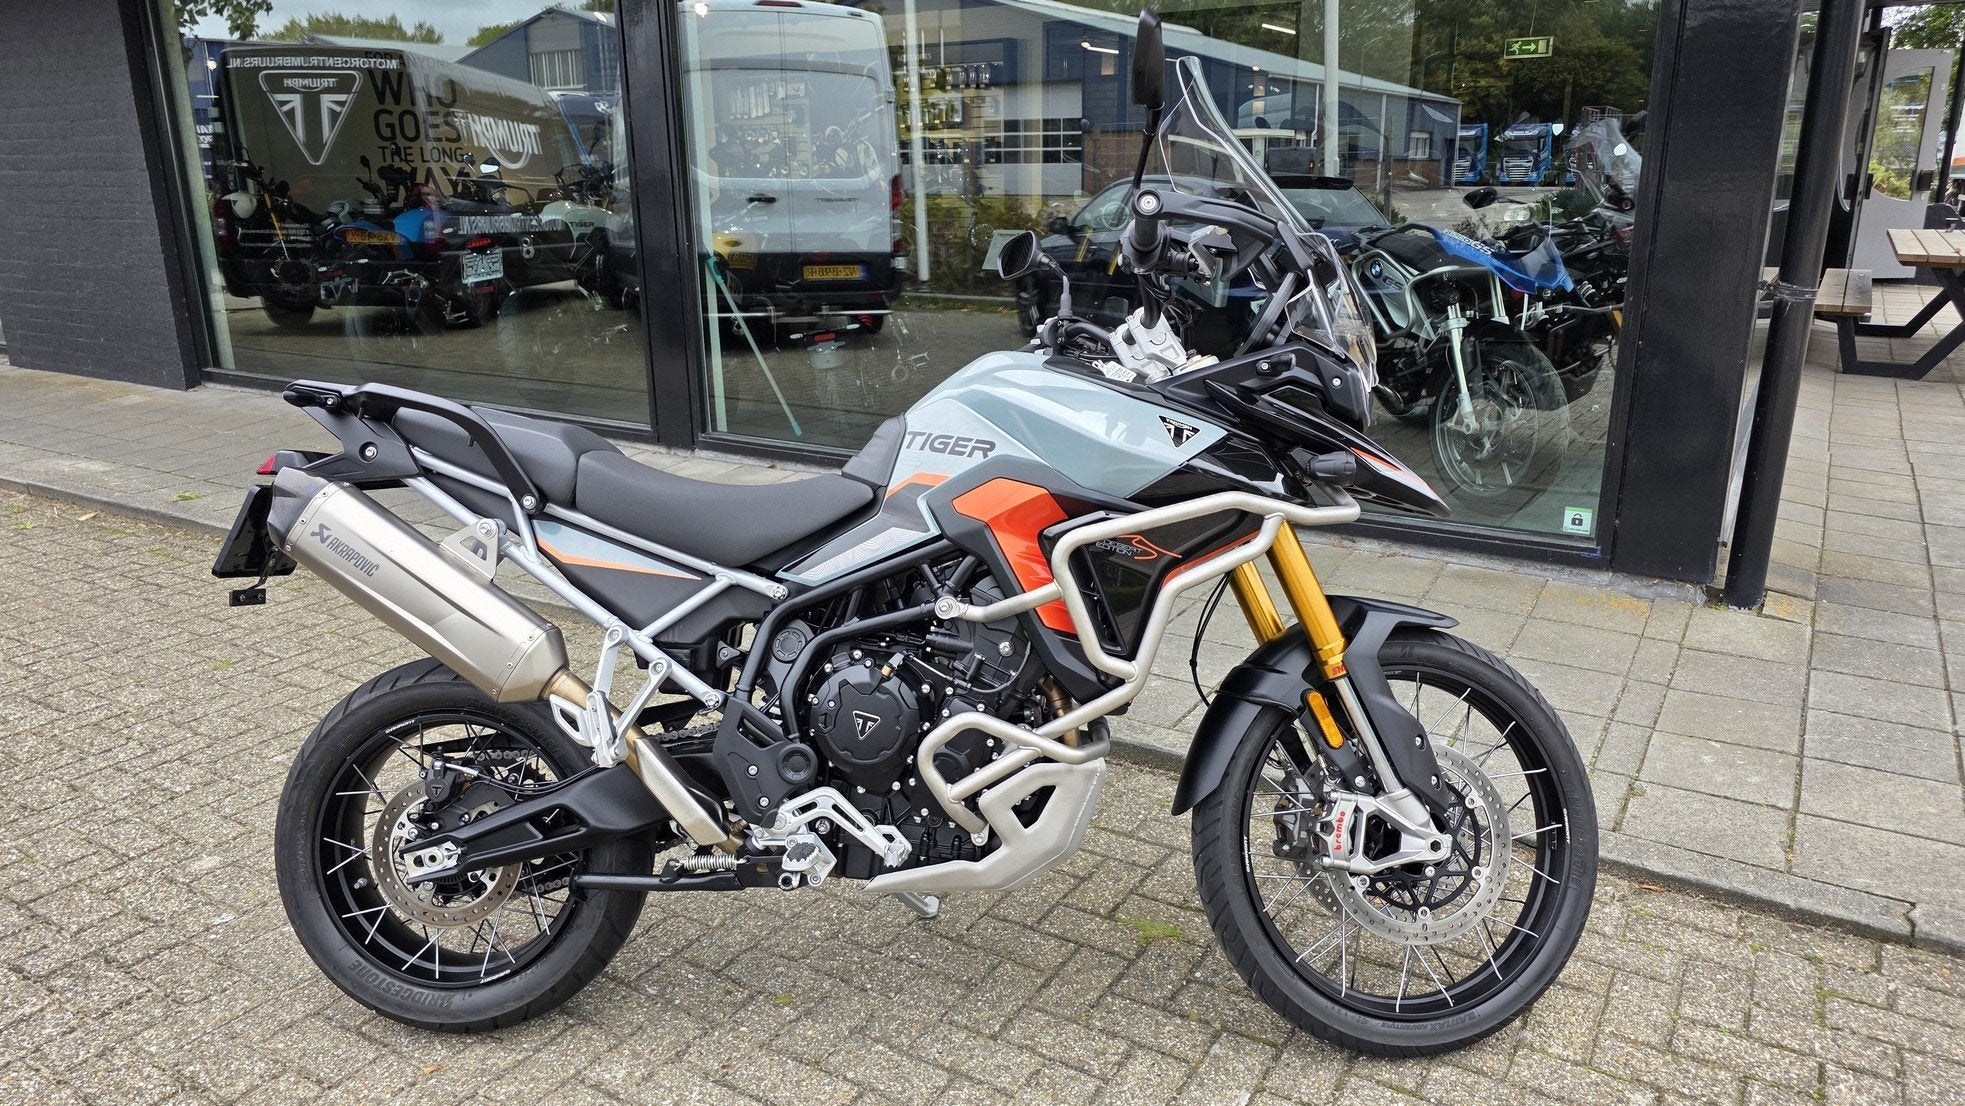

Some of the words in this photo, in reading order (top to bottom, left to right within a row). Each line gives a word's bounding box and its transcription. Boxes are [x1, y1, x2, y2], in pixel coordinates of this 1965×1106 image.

[367, 69, 458, 108] WHO
[374, 108, 462, 143] GOES
[420, 146, 464, 164] LONG
[905, 431, 996, 459] TIGER
[1095, 541, 1133, 556] EDITION
[1334, 811, 1346, 851] brembo
[347, 959, 455, 1009] BRIDGESTONE
